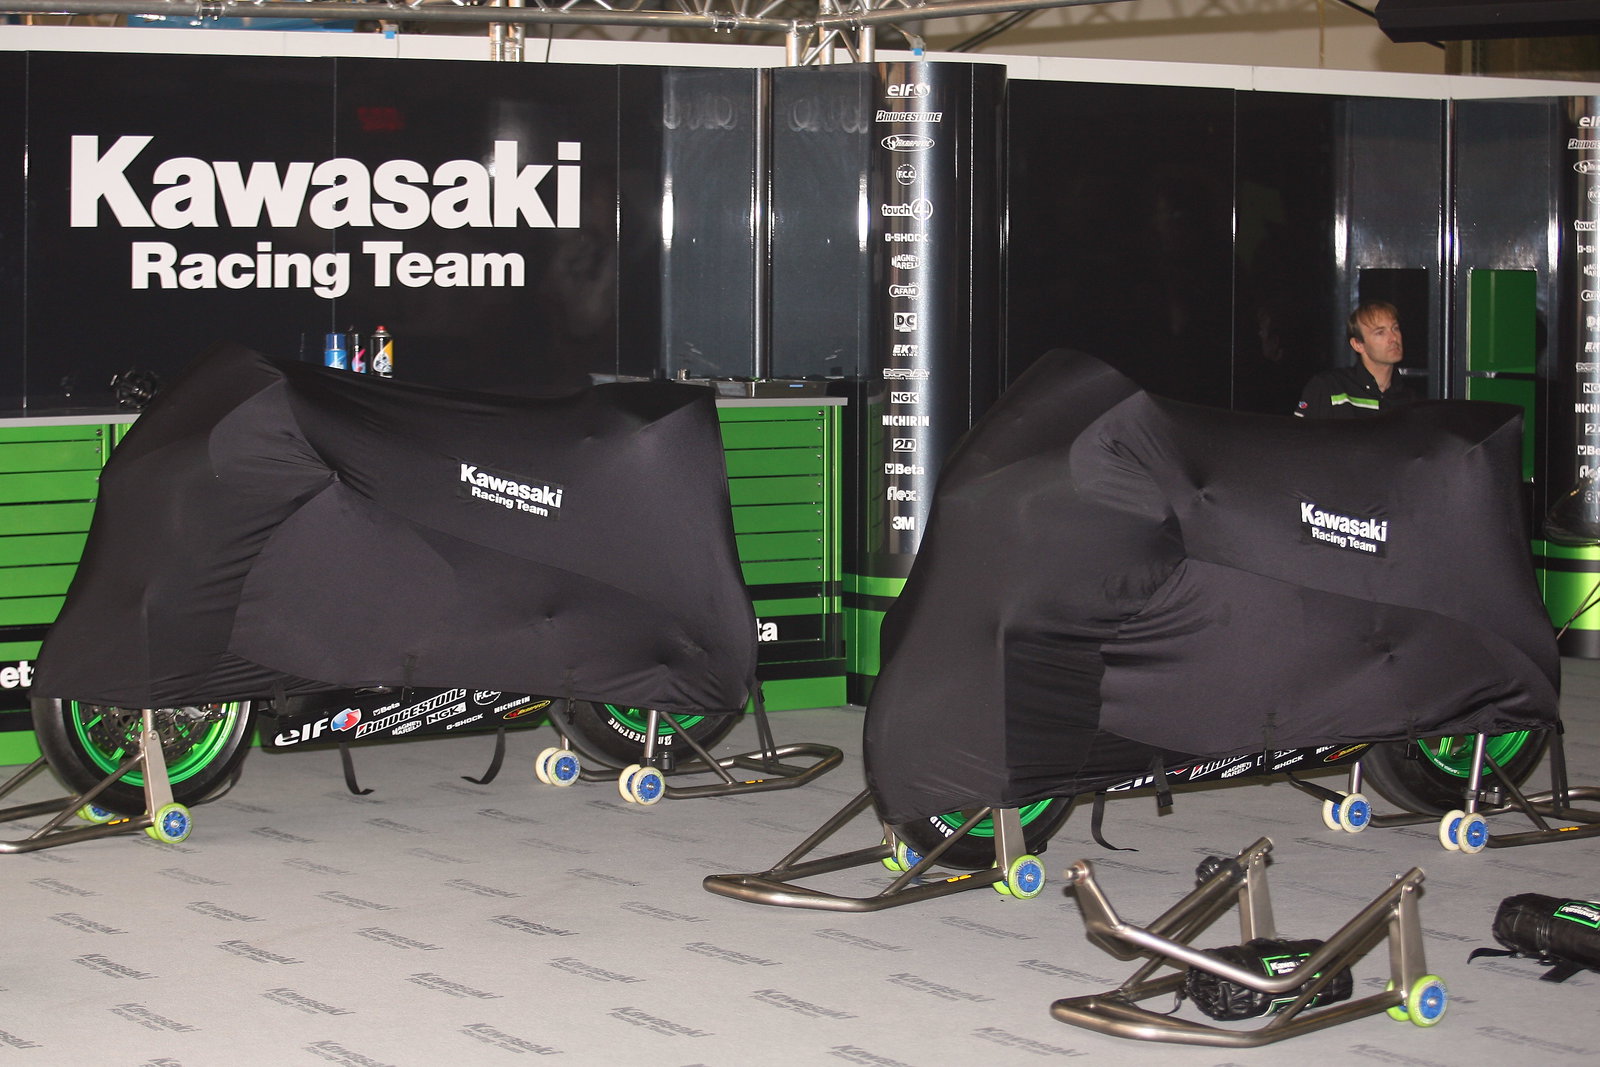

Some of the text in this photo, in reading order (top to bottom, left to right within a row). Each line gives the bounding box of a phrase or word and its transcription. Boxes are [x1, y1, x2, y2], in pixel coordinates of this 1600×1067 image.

[887, 83, 914, 97] elf
[876, 110, 942, 122] BRIDGESTONE
[71, 135, 581, 229] Kawasaki
[882, 204, 911, 215] touch
[885, 233, 928, 242] G-SHOCK
[131, 241, 526, 298] Racing Team
[892, 393, 918, 402] NGK
[882, 415, 930, 427] NICHIRIN
[895, 463, 924, 475] Beta
[460, 463, 563, 508] Kawasaki
[471, 486, 549, 517] Racing Team
[892, 516, 915, 531] 3M
[1300, 502, 1388, 542] Kawasaki
[1311, 527, 1377, 553] Racing Team
[354, 688, 467, 740] BRIDGESTONE
[427, 703, 462, 724] NGK
[494, 696, 530, 713] NICHIRIN
[274, 718, 329, 747] elf
